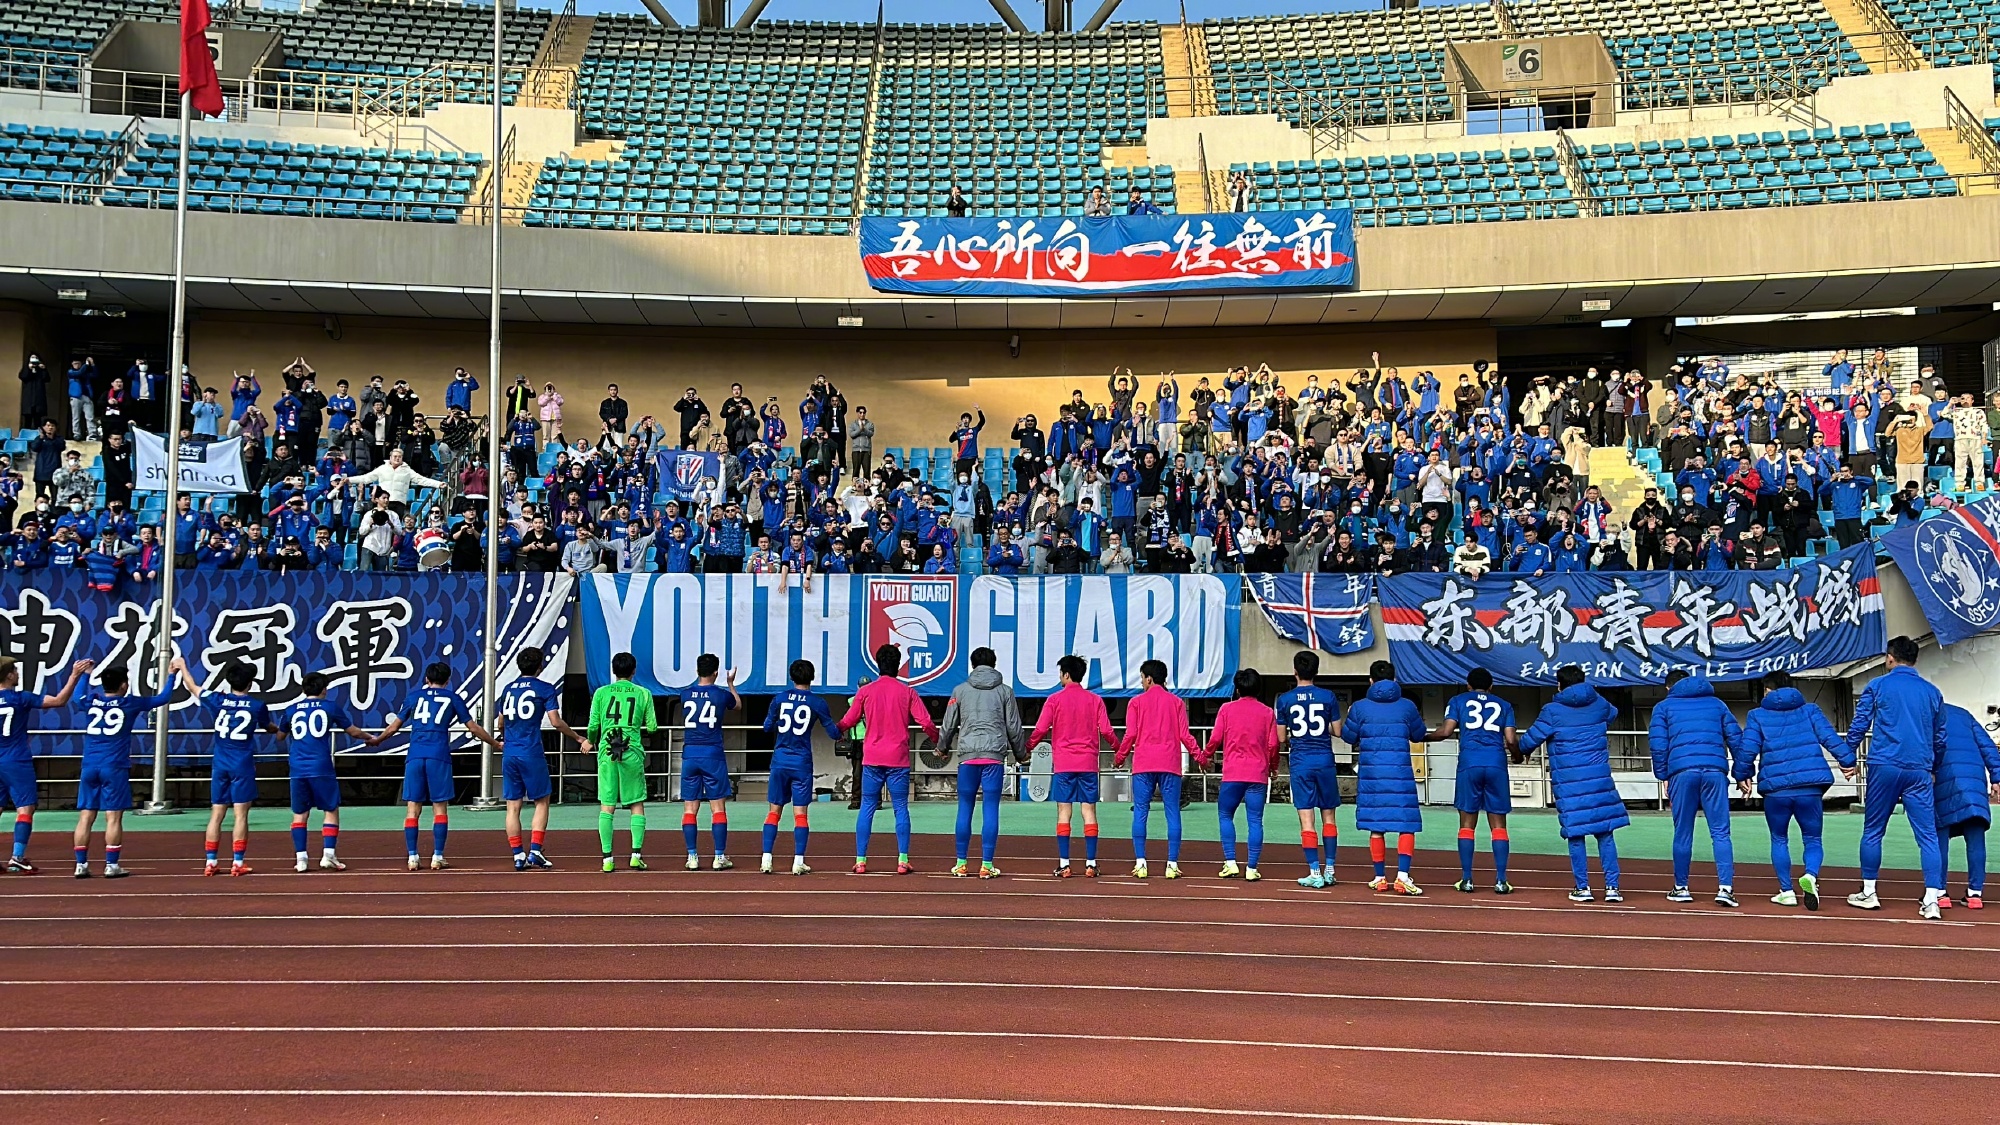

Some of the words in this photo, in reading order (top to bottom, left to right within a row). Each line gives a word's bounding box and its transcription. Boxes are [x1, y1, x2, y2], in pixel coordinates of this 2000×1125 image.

[1519, 49, 1539, 73] 6
[879, 219, 1090, 281] 吾心所向
[1122, 212, 1336, 273] 一往無前
[872, 584, 908, 602] YOUTH
[911, 585, 950, 602] GUARD
[1968, 598, 1994, 622] SSFC
[592, 573, 850, 688] YOUTH
[968, 574, 1226, 690] GUARD
[1744, 650, 1811, 675] FRONT
[414, 697, 451, 724] 47
[503, 690, 536, 720] 46
[606, 696, 636, 726] 41
[684, 701, 717, 728] 24
[778, 702, 811, 735] 59
[1466, 700, 1501, 732] 32
[87, 707, 125, 735] 29
[215, 709, 252, 740] 42
[291, 709, 328, 740] 60
[1290, 704, 1325, 737] 35
